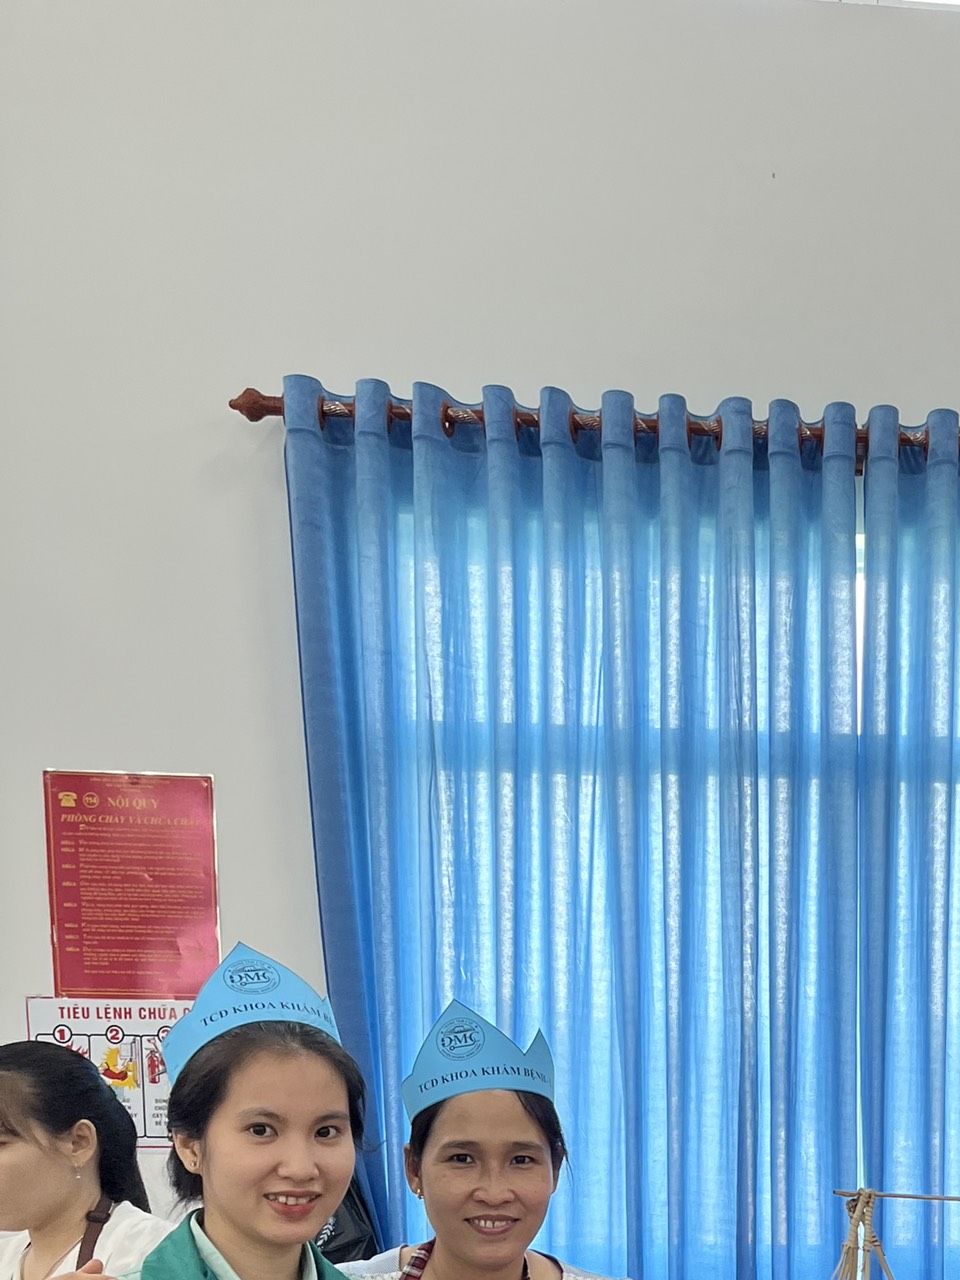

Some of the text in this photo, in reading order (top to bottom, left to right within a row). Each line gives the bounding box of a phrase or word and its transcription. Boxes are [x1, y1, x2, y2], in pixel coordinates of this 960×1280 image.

[107, 795, 129, 809] NỘI
[60, 812, 96, 823] PHÒNG
[96, 1003, 132, 1022] LỆNH
[138, 1004, 178, 1020] CHỮA
[232, 1001, 276, 1014] KHOA
[280, 1001, 321, 1018] KHÁM
[57, 1028, 66, 1041] 1
[109, 1028, 120, 1041] 2
[441, 1069, 478, 1084] KHOA
[481, 1063, 521, 1076] KHÁM
